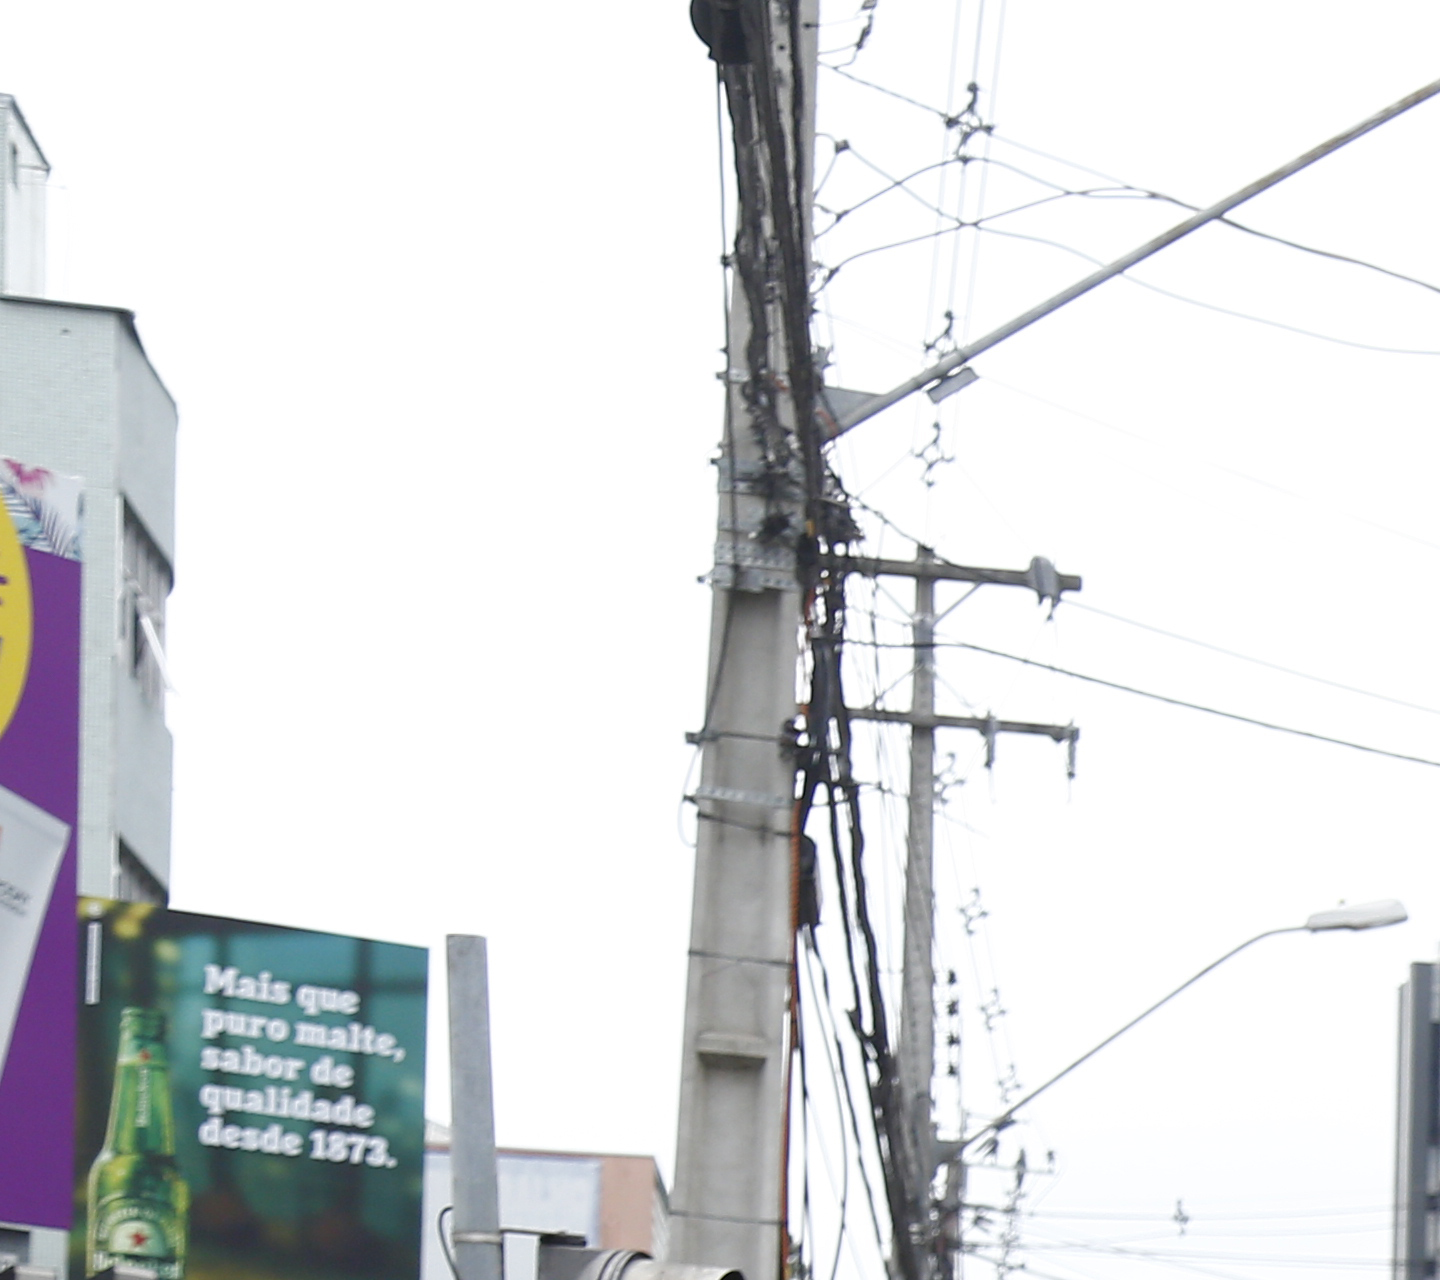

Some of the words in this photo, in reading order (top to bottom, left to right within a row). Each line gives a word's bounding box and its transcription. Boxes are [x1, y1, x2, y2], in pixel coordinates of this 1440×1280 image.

[203, 963, 292, 1005] Mais
[296, 984, 361, 1016] que
[202, 1007, 290, 1042] puro
[293, 1021, 406, 1063] malte,
[201, 1045, 306, 1081] sabor
[310, 1055, 355, 1088] de
[200, 1084, 376, 1129] qualidade
[198, 1116, 304, 1157] desde
[309, 1128, 398, 1169] 1873.
